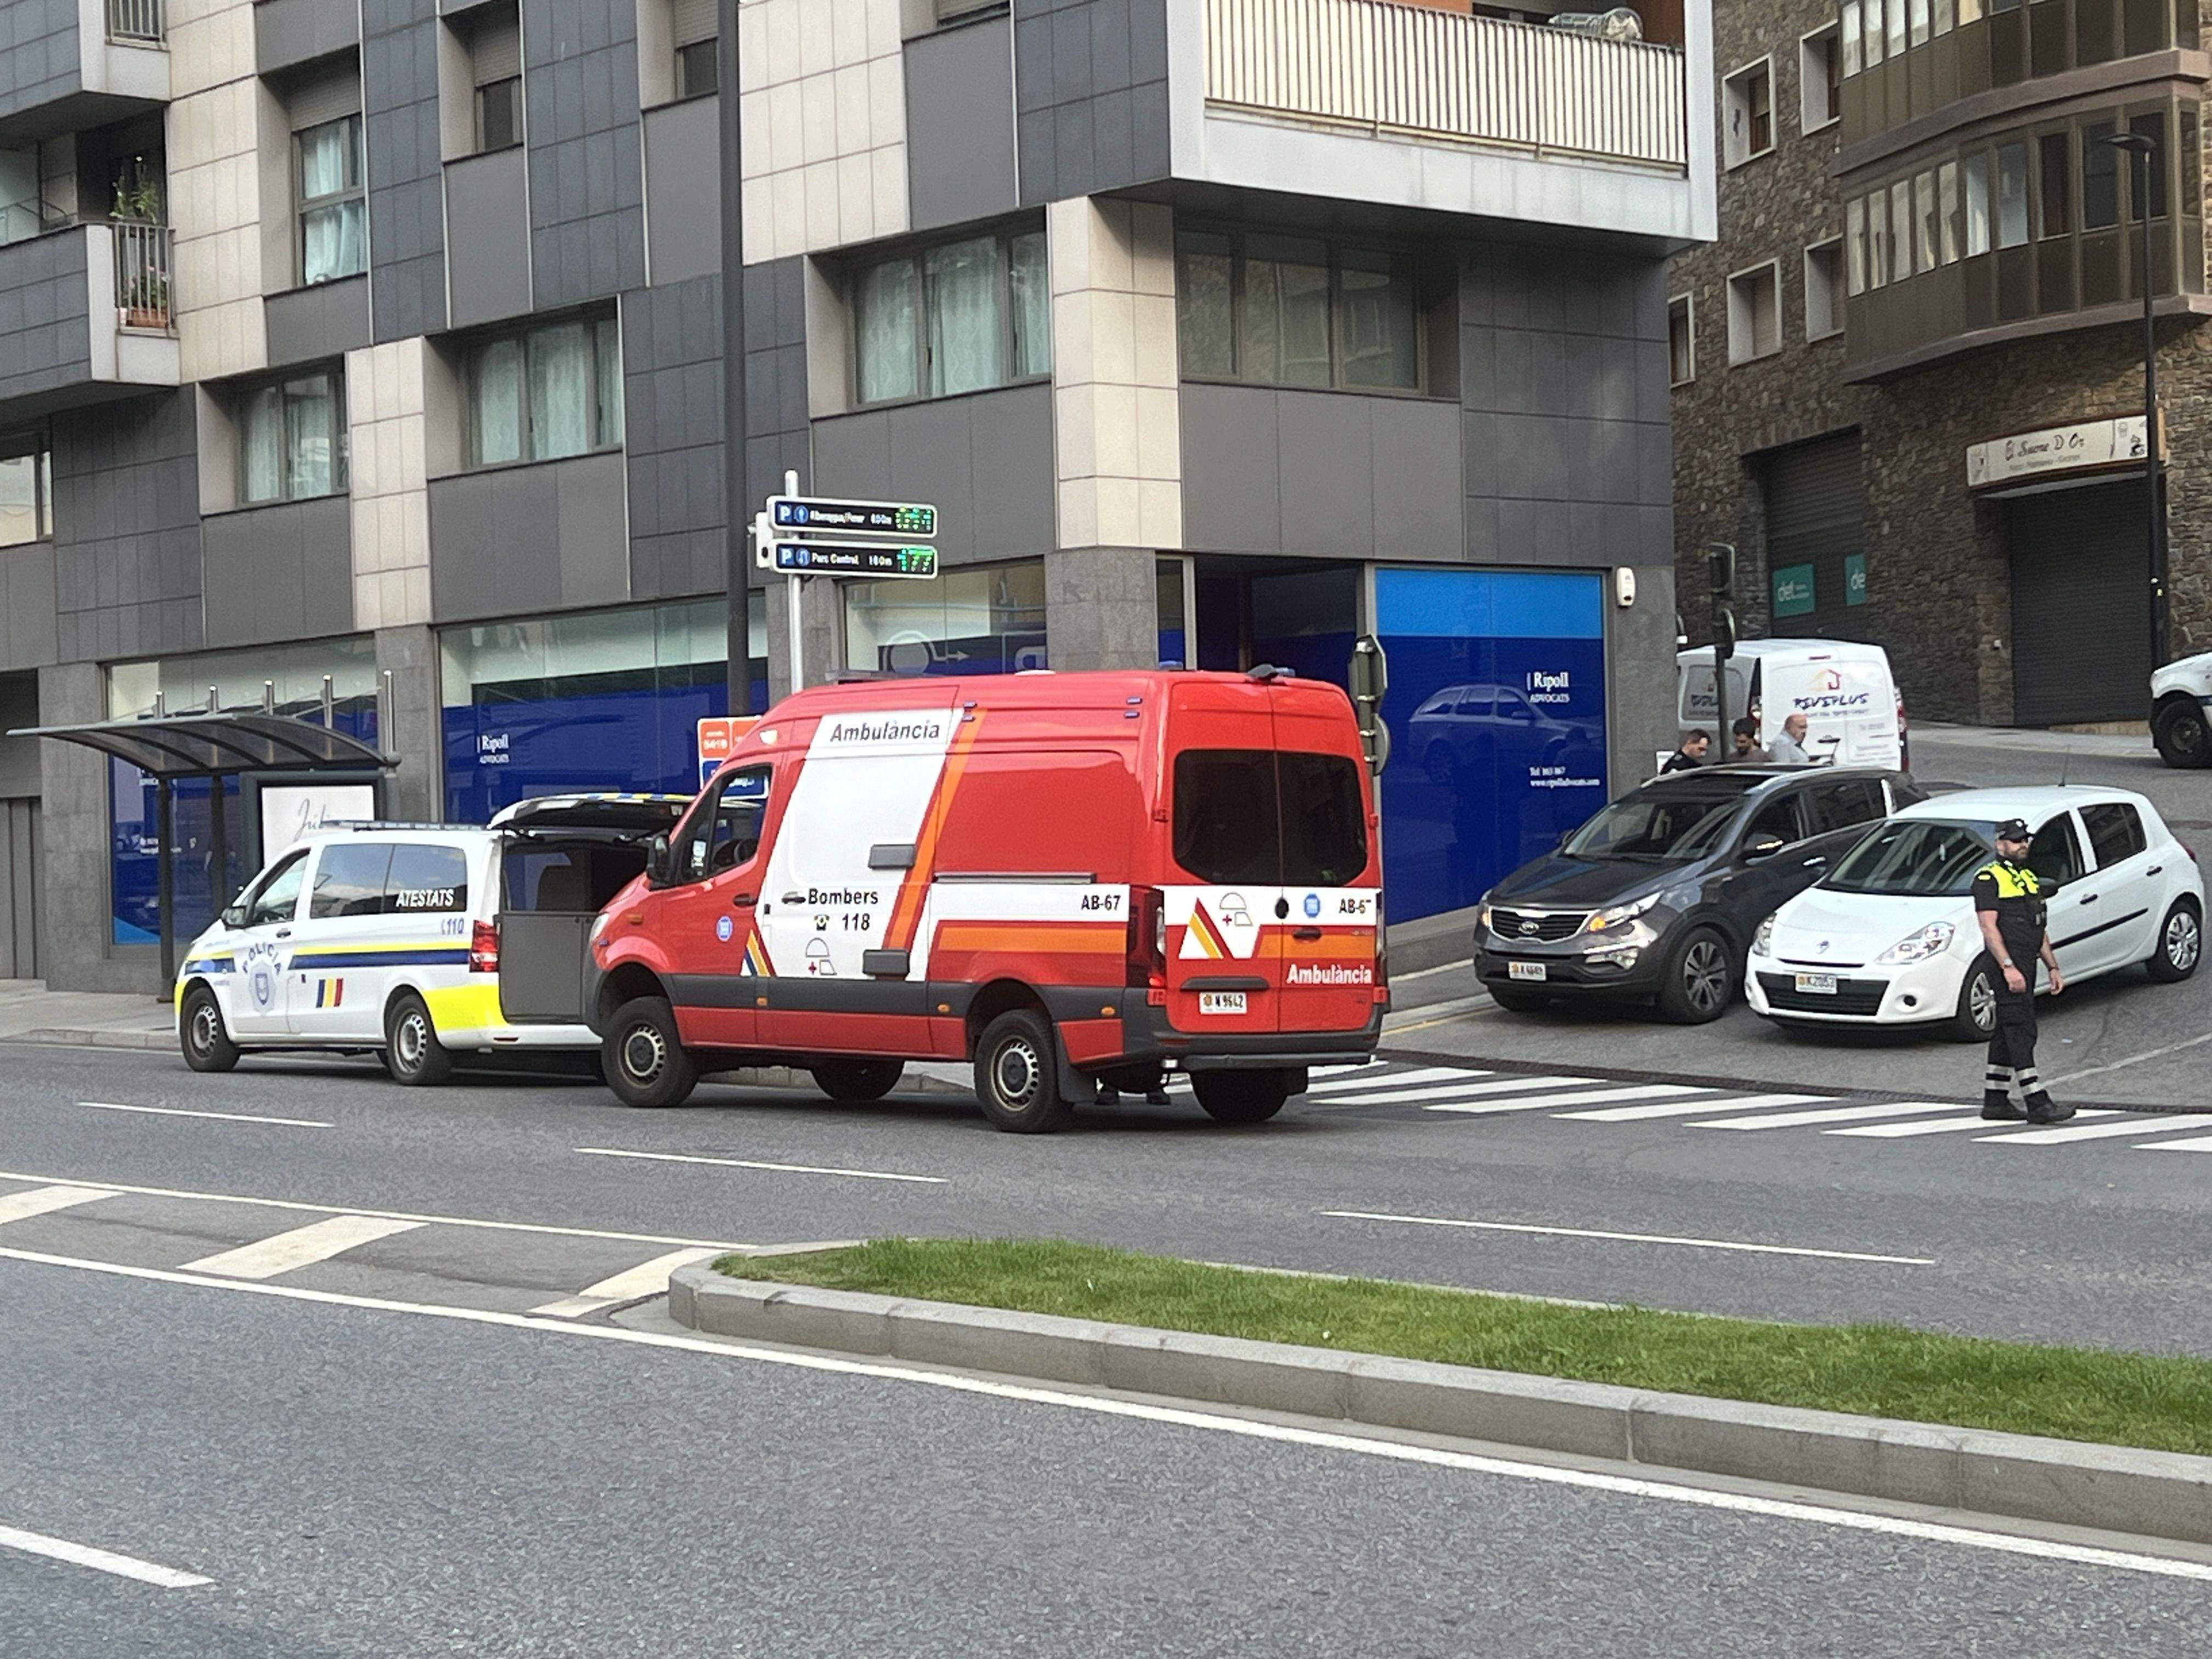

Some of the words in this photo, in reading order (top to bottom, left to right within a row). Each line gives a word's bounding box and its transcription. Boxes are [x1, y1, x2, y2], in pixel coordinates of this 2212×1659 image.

[1533, 671, 1569, 692] Ripoll
[482, 733, 509, 753] Ripoll
[395, 888, 454, 907] ATESTATS
[808, 887, 879, 905] Bombers
[1081, 894, 1121, 911] AB-67
[842, 913, 870, 931] 118
[242, 941, 282, 976] POLICIA
[1286, 963, 1372, 984] Ambulància
